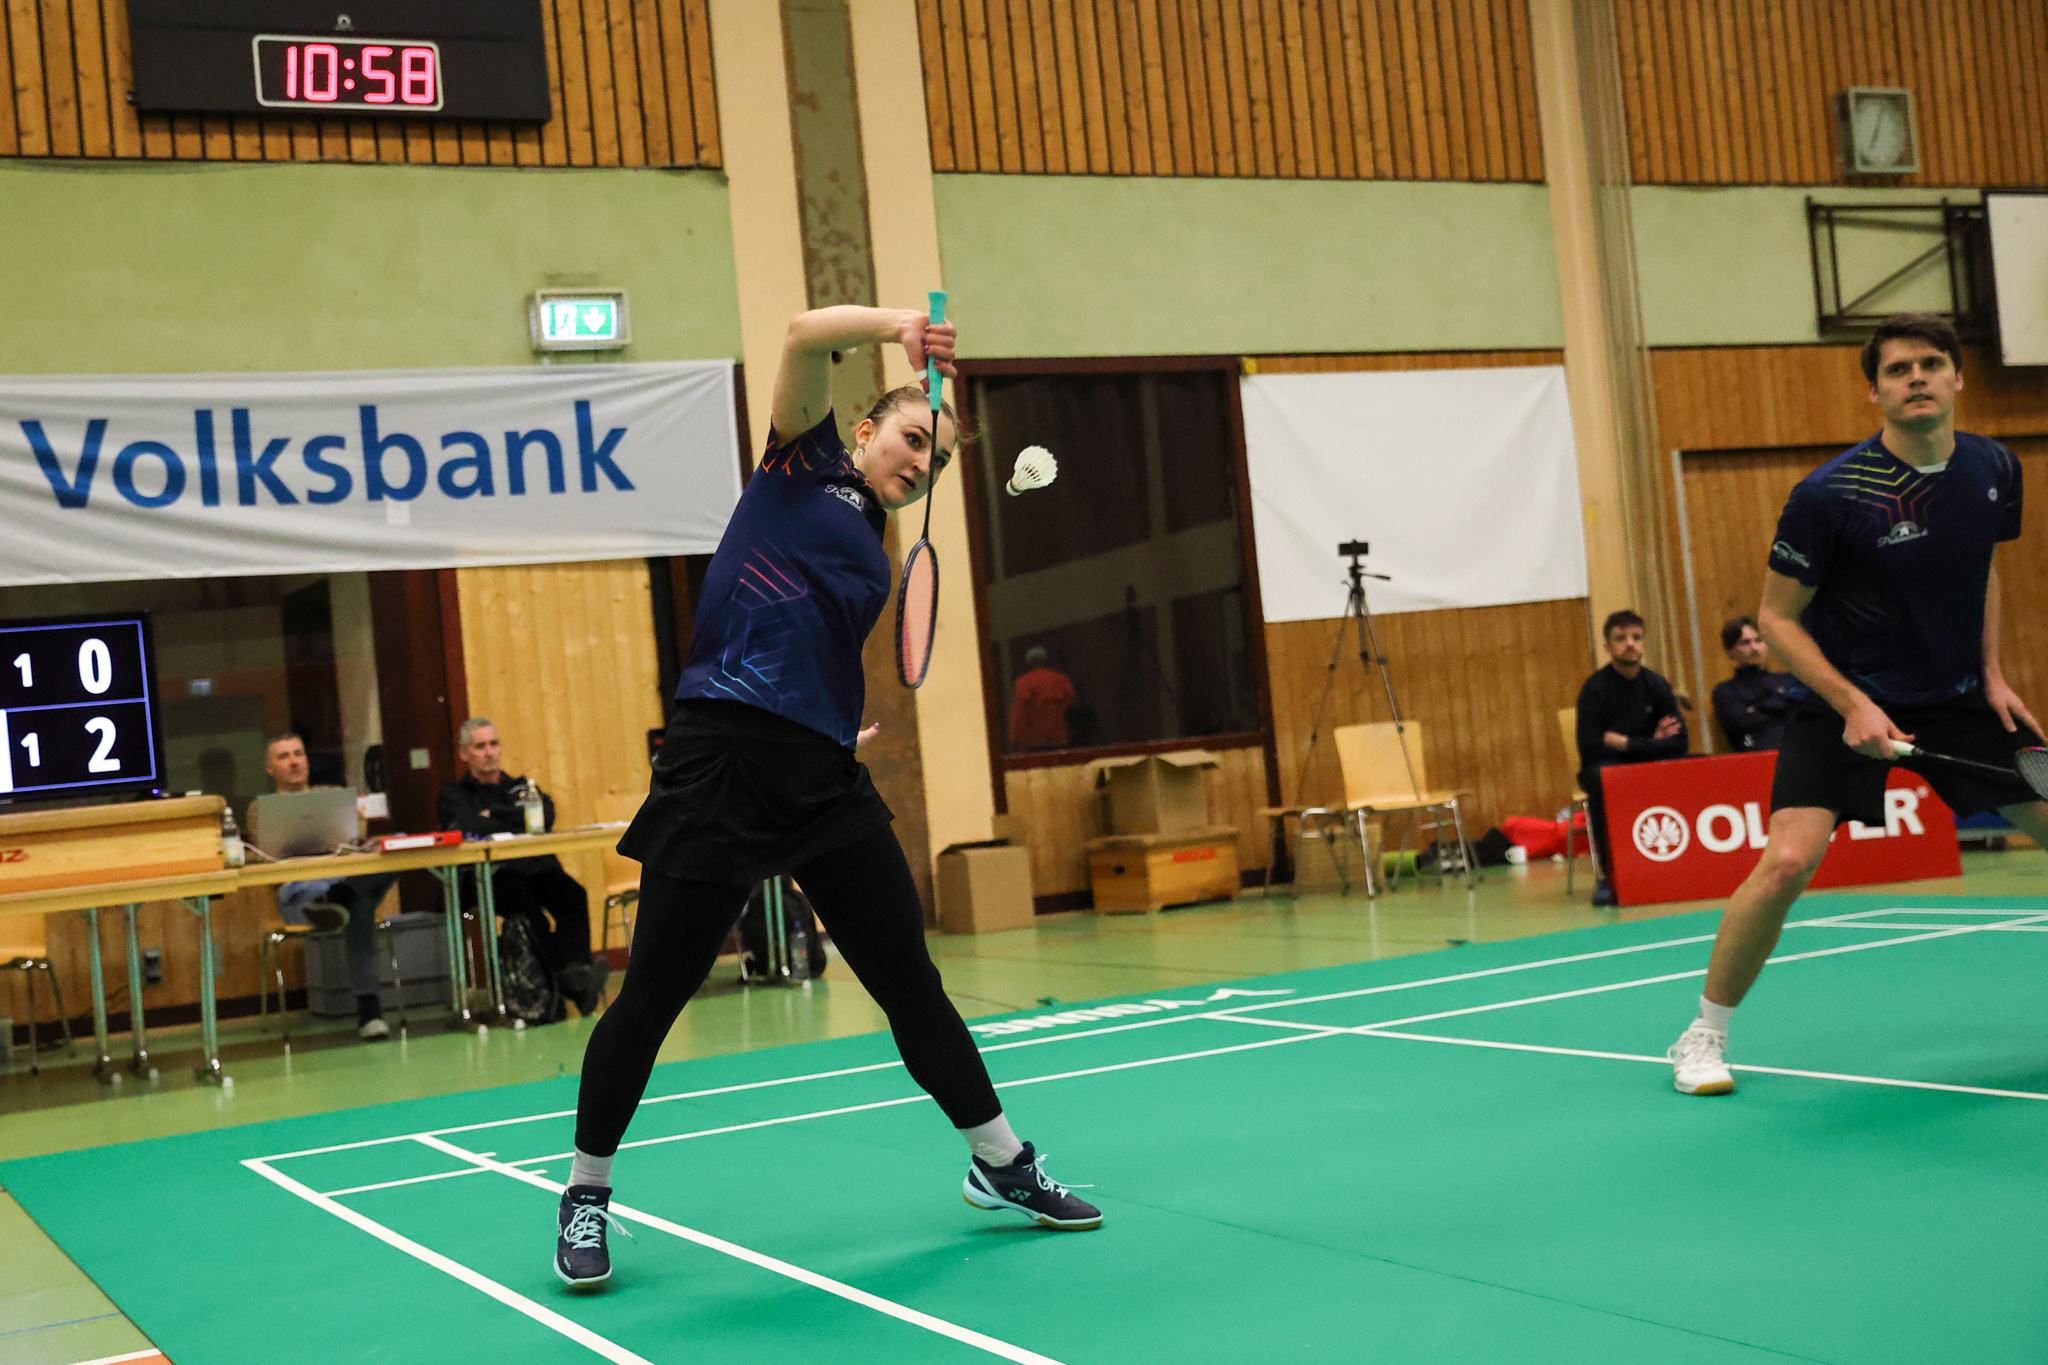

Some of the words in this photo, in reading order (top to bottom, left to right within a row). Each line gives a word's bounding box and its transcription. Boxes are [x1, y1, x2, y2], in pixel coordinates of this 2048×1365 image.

[286, 44, 436, 105] 10:58
[20, 400, 635, 509] Volksbank
[13, 652, 34, 688] 1
[78, 638, 112, 695] 0
[20, 732, 41, 768] 1
[84, 716, 121, 773] 2
